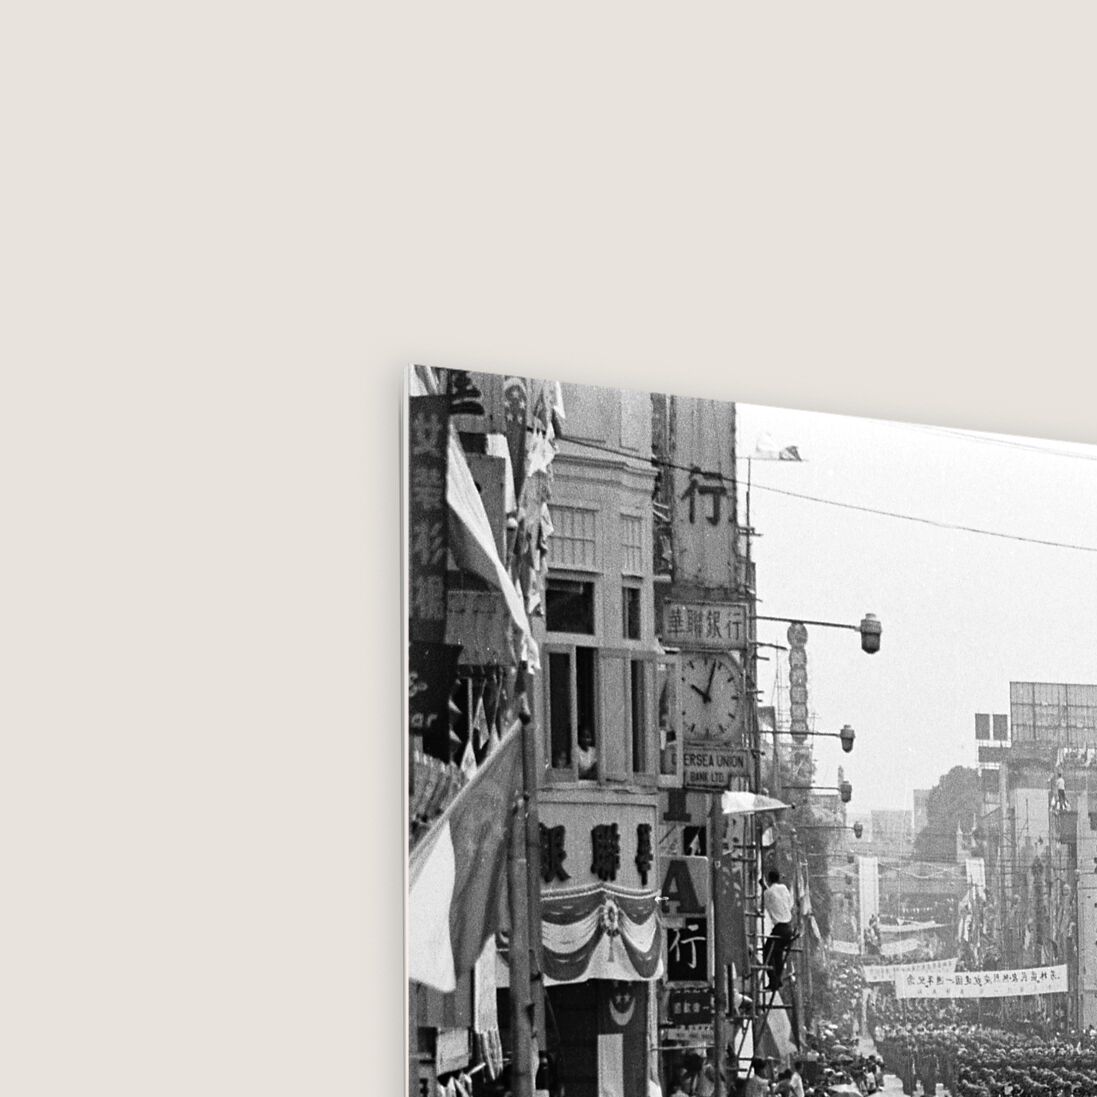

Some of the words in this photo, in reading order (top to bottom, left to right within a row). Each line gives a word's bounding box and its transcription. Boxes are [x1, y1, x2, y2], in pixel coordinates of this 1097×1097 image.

[681, 466, 727, 526] 行
[667, 608, 742, 640] 華聯銀行
[690, 771, 709, 782] BANK
[716, 755, 744, 768] UNION
[669, 924, 706, 969] 行
